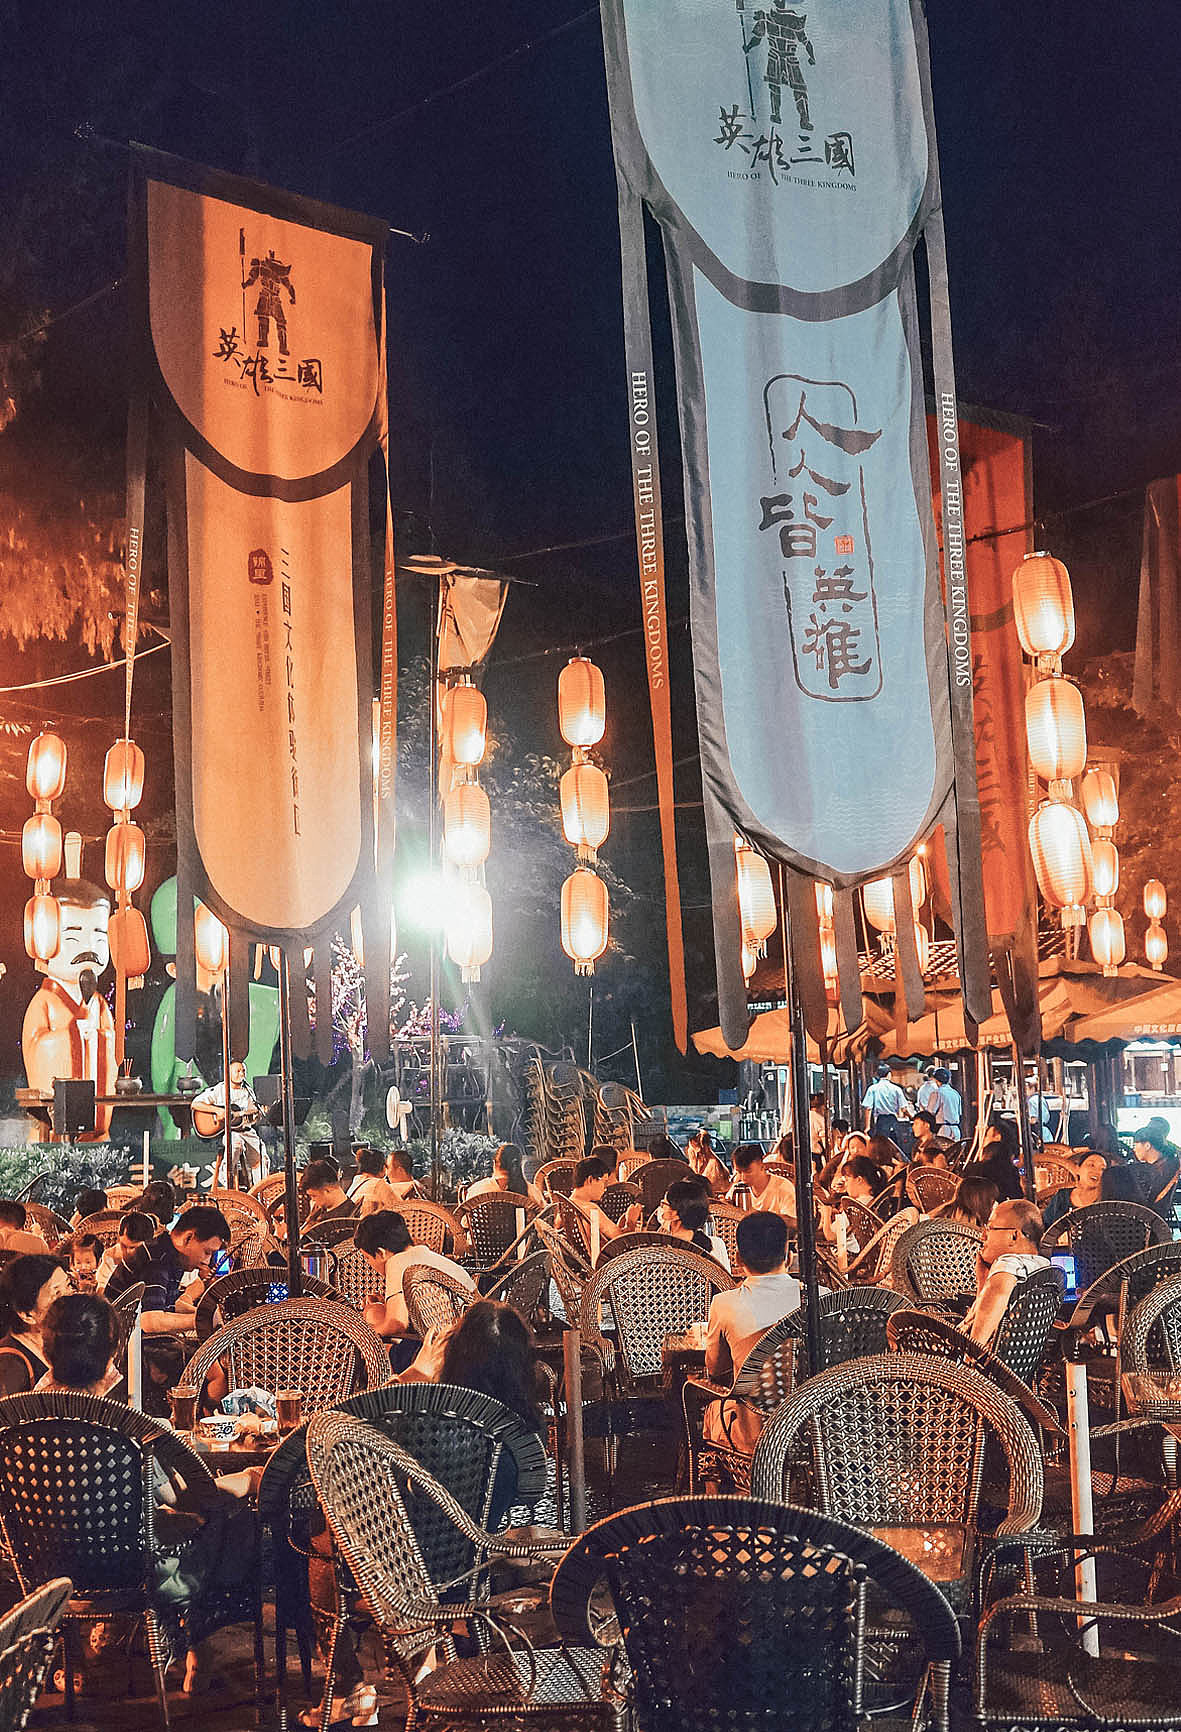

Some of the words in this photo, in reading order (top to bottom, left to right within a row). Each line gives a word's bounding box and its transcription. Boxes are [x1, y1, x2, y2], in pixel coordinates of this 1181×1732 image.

[631, 371, 649, 426] HERO
[942, 392, 958, 442] HERO
[634, 430, 651, 458] OF
[945, 446, 959, 472] OF
[637, 463, 653, 506] THE
[946, 479, 961, 519] THE
[128, 527, 139, 570] HERO
[639, 508, 657, 576] THREE
[948, 520, 966, 581] THREE
[128, 573, 138, 597] OF
[383, 570, 393, 611] HERO
[382, 612, 392, 632] OF
[644, 579, 664, 689] KINGDOMS
[952, 584, 971, 687] KINGDOMS
[382, 640, 392, 666] THE
[382, 667, 392, 718] THREE
[381, 719, 391, 800] KINGDOMS
